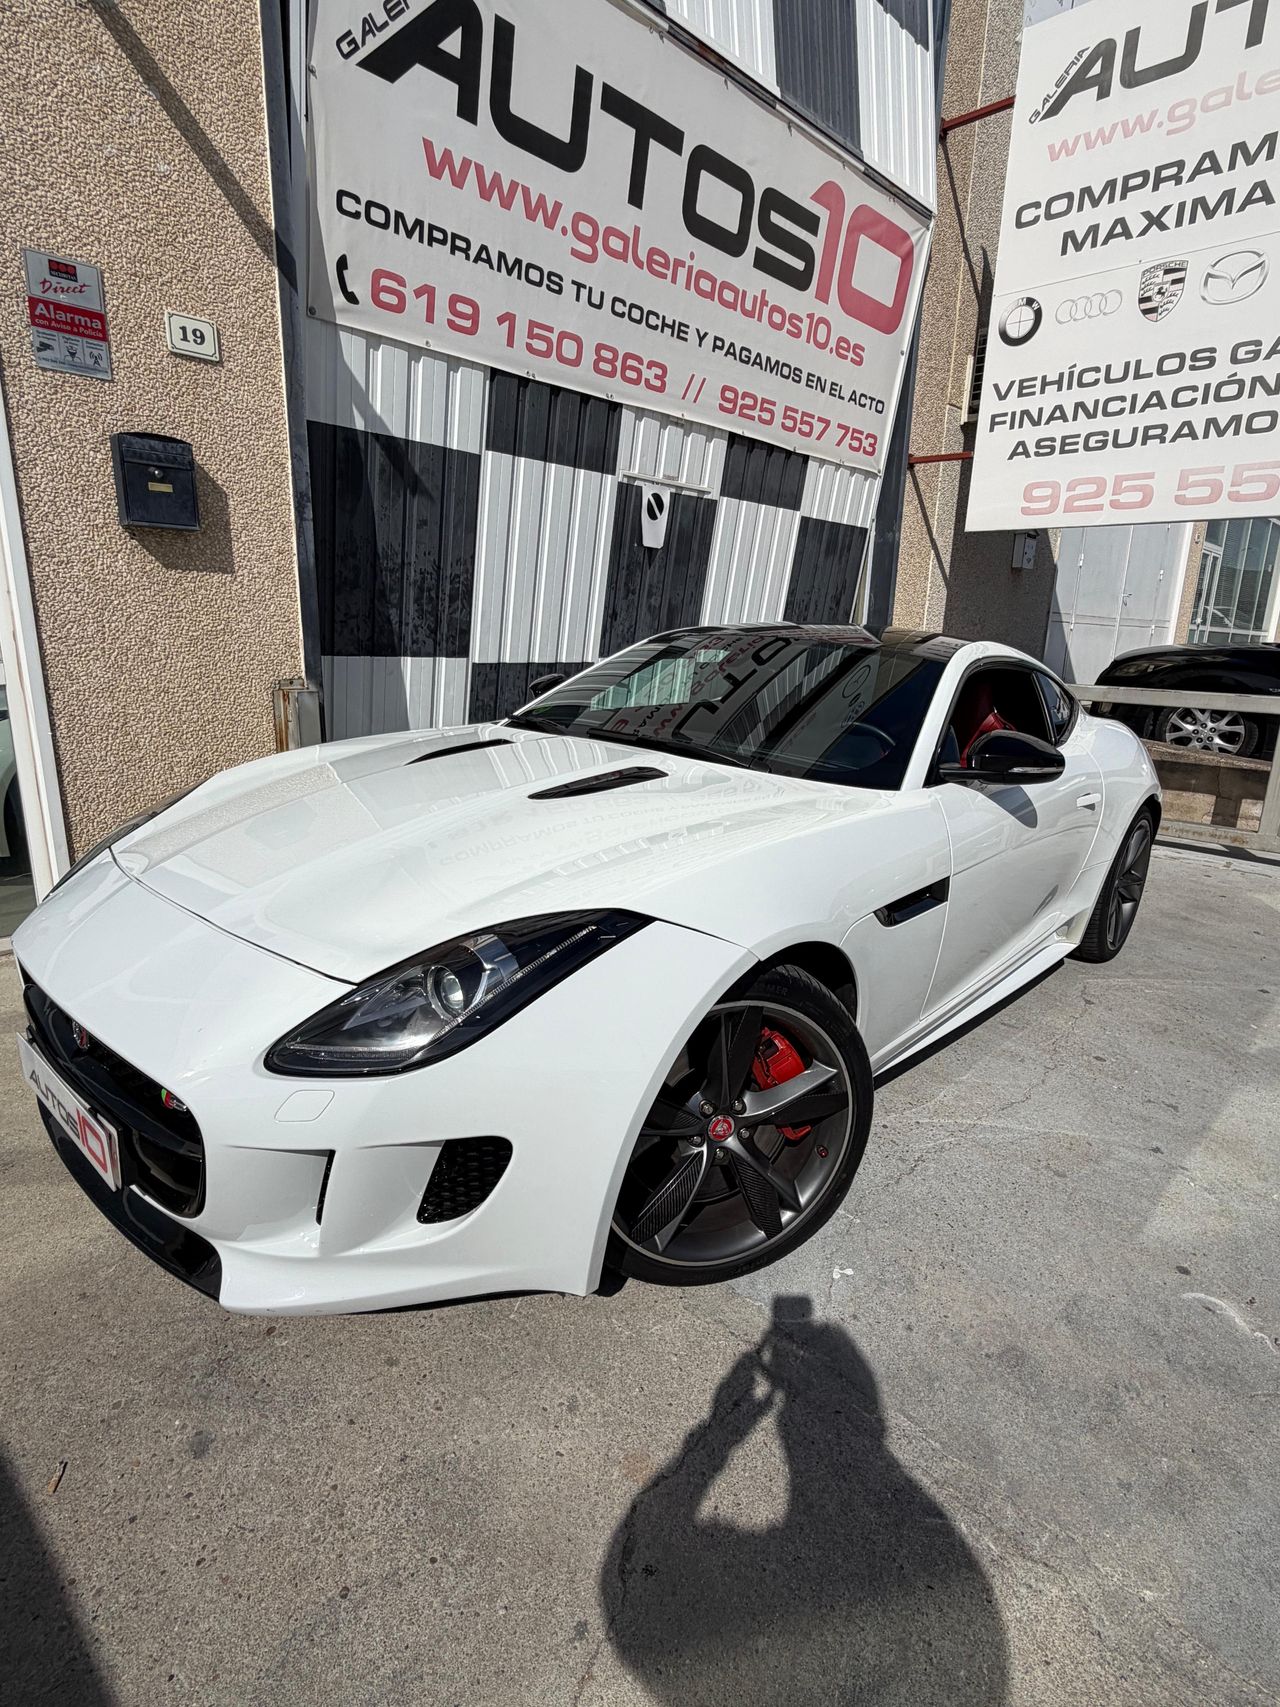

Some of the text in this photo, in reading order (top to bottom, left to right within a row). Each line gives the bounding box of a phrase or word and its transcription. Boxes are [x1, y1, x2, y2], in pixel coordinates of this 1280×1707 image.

[1028, 46, 1091, 125] GALERIA
[1046, 68, 1280, 162] www.gale
[1014, 130, 1279, 230] COMPRAM
[1060, 179, 1276, 257] MAXIMA
[39, 277, 92, 294] Direct
[422, 137, 865, 367] www.galeriaautos10.es
[34, 302, 102, 330] Alarma
[178, 325, 206, 346] 19
[336, 189, 885, 415] COMPRAMOS TU COCHE Y PAGAMOS EN EL ACTO
[370, 268, 481, 337] 619
[496, 311, 584, 369] 150
[591, 342, 668, 394] 863
[718, 384, 778, 427] 925
[780, 405, 832, 441] 557
[835, 422, 878, 458] 753
[989, 371, 1280, 433] FINANCIACIÓN
[993, 346, 1218, 402] VEHÍCULOS
[1006, 409, 1279, 461] ASEGURAMO
[1018, 461, 1280, 518] 925 55
[29, 1069, 108, 1174] AUTOS10
